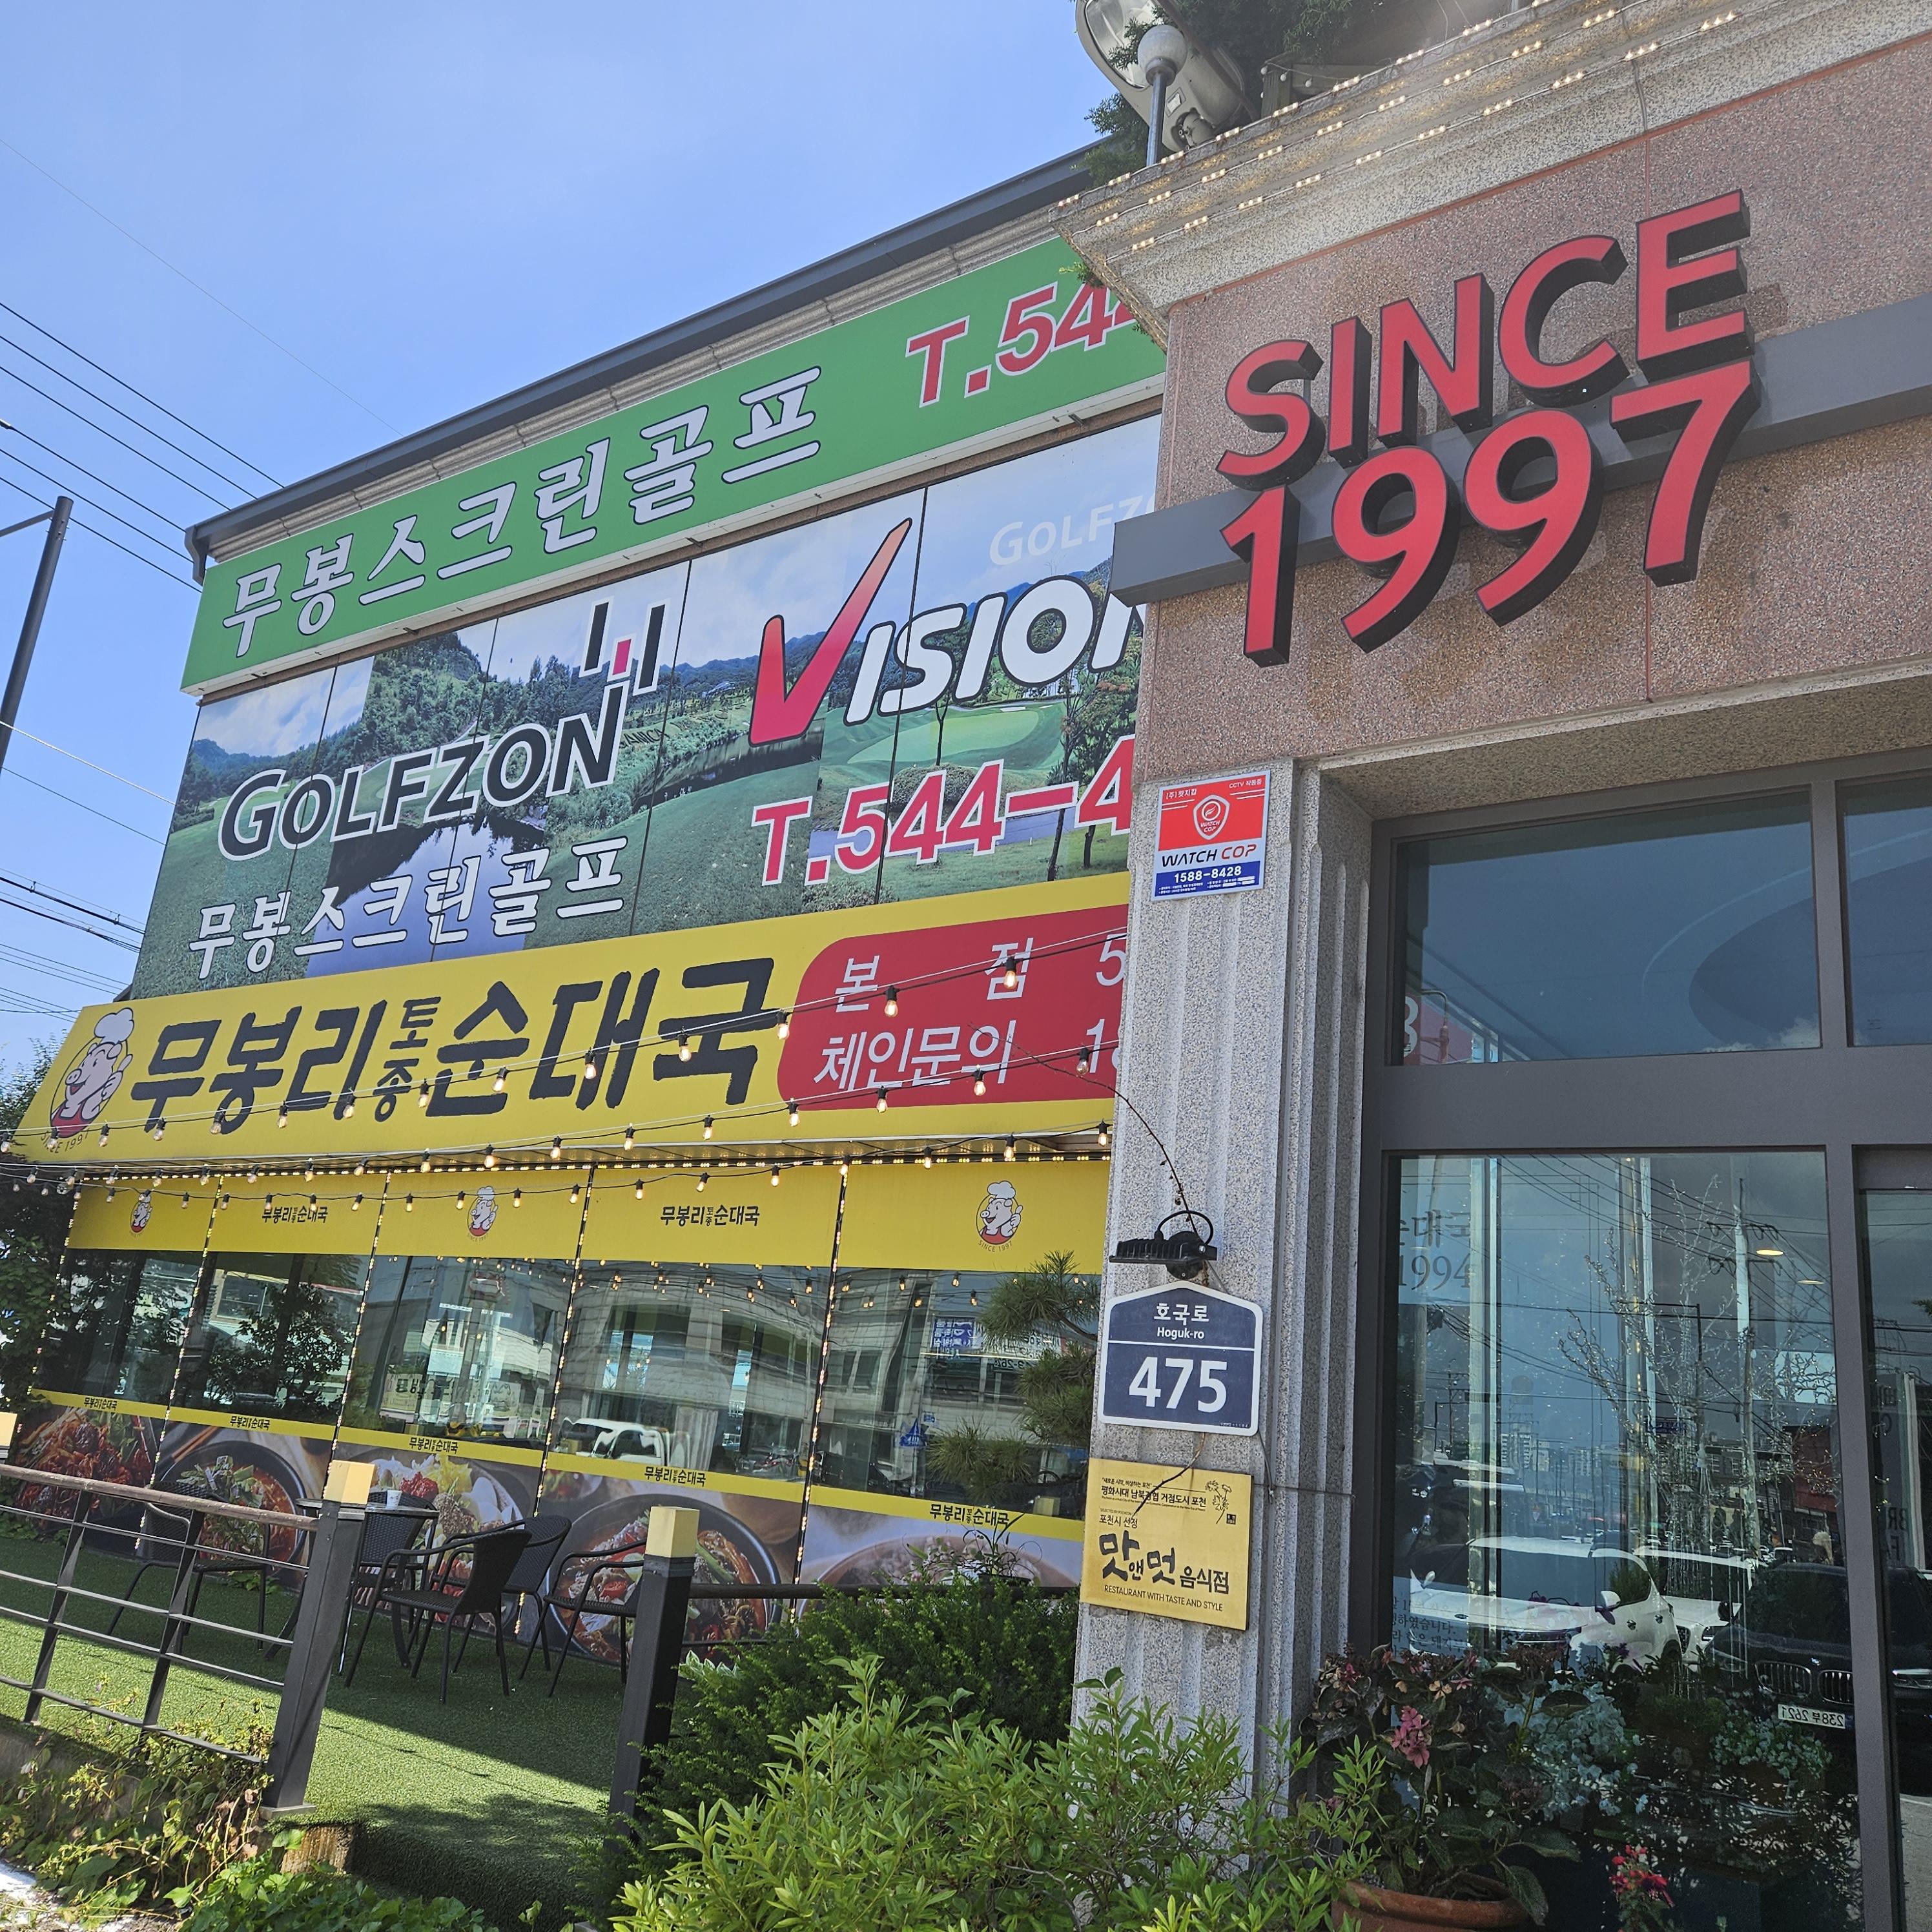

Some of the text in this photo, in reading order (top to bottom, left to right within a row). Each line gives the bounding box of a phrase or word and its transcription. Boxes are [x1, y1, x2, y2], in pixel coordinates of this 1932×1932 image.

[1215, 188, 1755, 491] SINCE
[223, 366, 821, 658] 무봉스크린골프
[1220, 358, 1761, 668] 1997
[989, 492, 1155, 565] GOLFZ
[1229, 781, 1244, 789] CCTV
[1162, 843, 1257, 867] WATCH COP
[1174, 865, 1242, 883] 1588-8428
[189, 836, 628, 980] 무봉스크린골프
[813, 1020, 1016, 1091] 체인문의
[978, 1240, 1012, 1253] SINCE 1997
[1154, 1303, 1209, 1326] 호국로
[1156, 1327, 1205, 1340] Hoguk-ro
[1129, 1356, 1228, 1413] 475
[1101, 1485, 1129, 1498] 평화시대
[1161, 1492, 1190, 1506] 거점도시
[1191, 1497, 1207, 1508] 포천
[1099, 1514, 1122, 1527] 포천시
[1180, 1565, 1229, 1595] 음식점
[1104, 1585, 1223, 1612] RESTAURANT WITH TASTE AND STYLE
[1393, 1614, 1455, 1634] 하였습니다.
